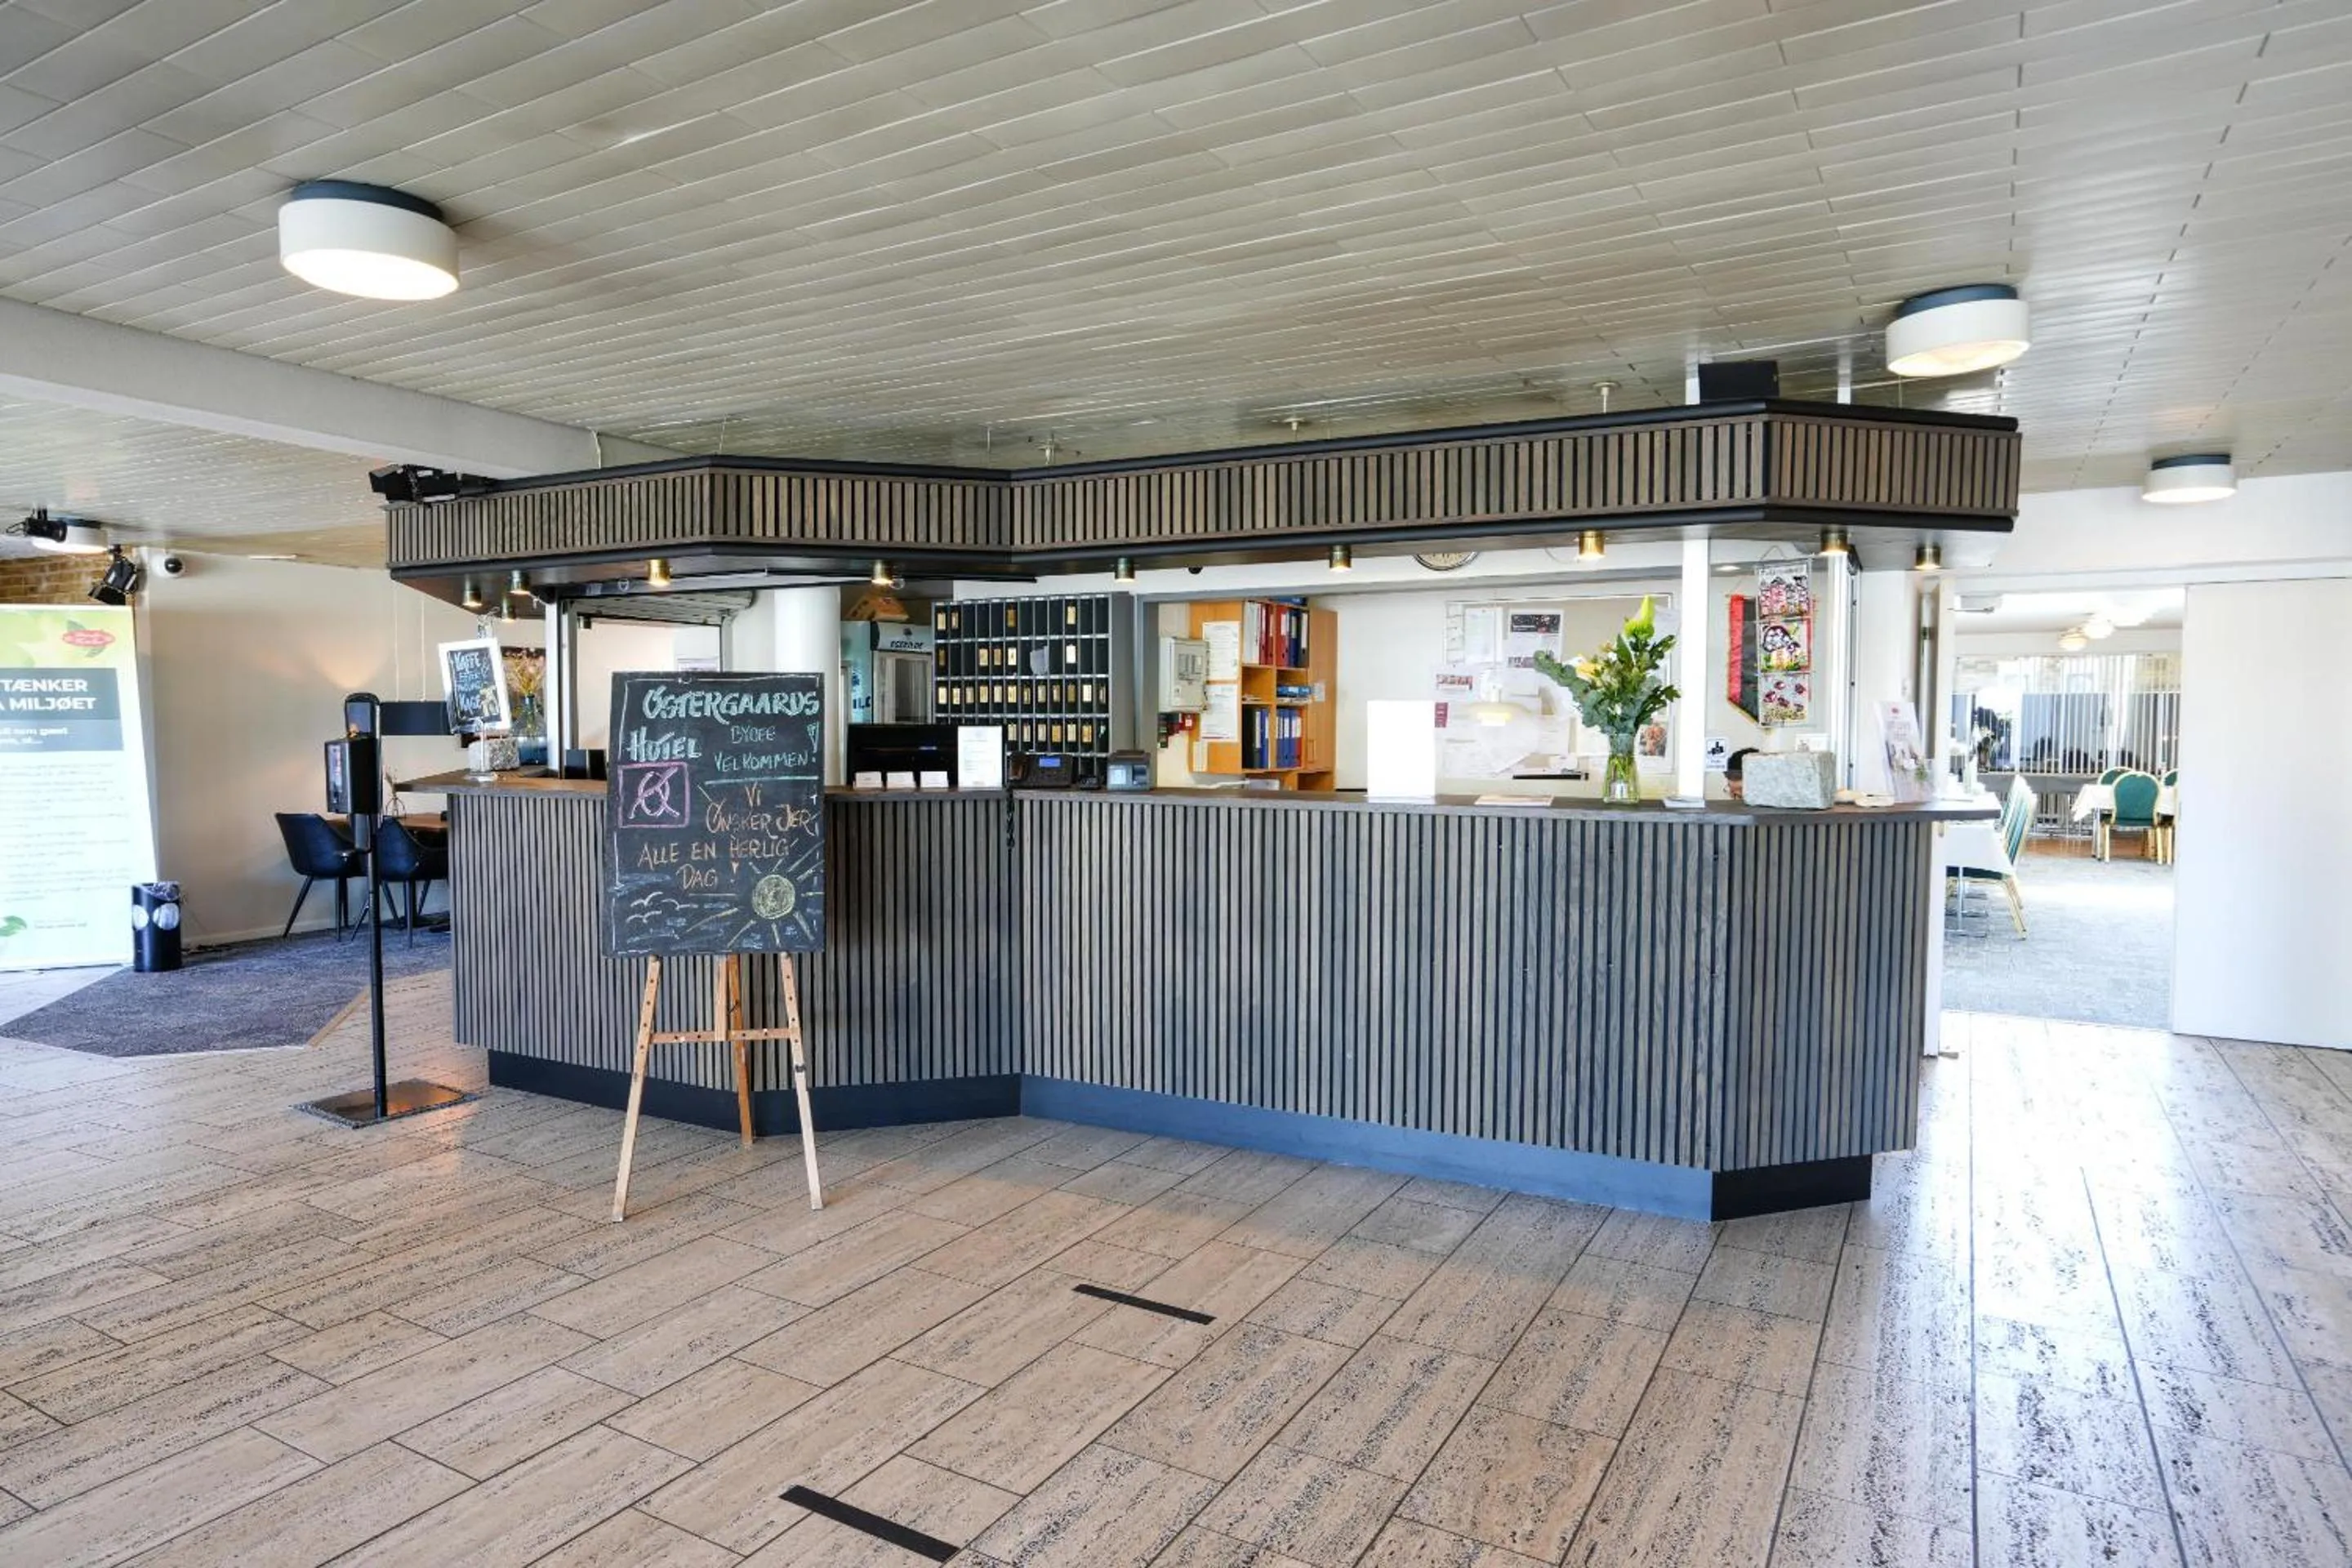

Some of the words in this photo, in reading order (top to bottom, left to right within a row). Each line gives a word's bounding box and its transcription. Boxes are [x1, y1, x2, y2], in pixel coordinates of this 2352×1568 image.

[1, 679, 88, 693] TÆNKER
[9, 696, 96, 710] MILJØET
[626, 726, 702, 763] HOTEL
[638, 841, 680, 871] ALLE
[690, 842, 717, 861] EN
[675, 863, 719, 890] DAG
